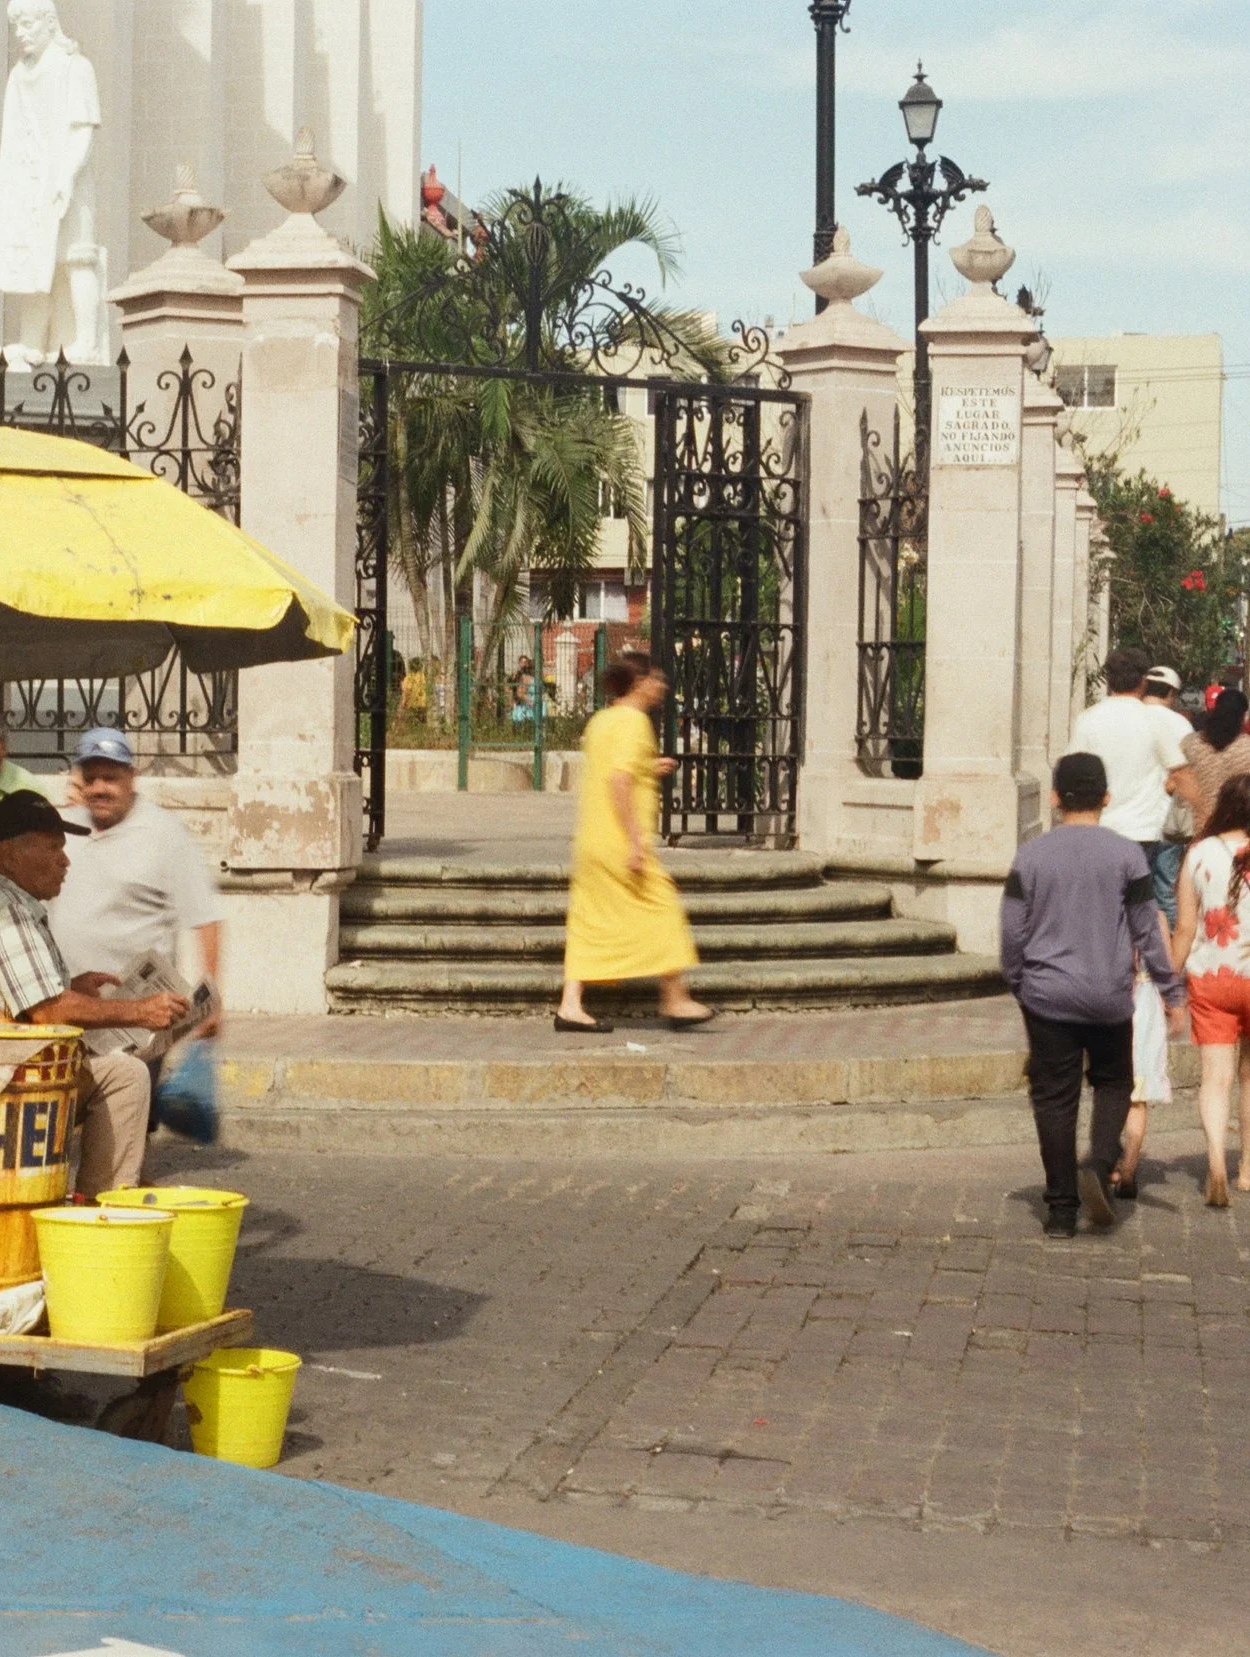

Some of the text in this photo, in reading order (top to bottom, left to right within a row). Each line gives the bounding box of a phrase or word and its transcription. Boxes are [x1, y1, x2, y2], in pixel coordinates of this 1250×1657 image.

[940, 386, 1016, 397] RESPETEMOS
[962, 398, 997, 408] ESTE
[956, 410, 1000, 419] LUGAR
[941, 432, 1016, 441] NO FIJANDO
[944, 443, 1010, 452] ANUNCIOS
